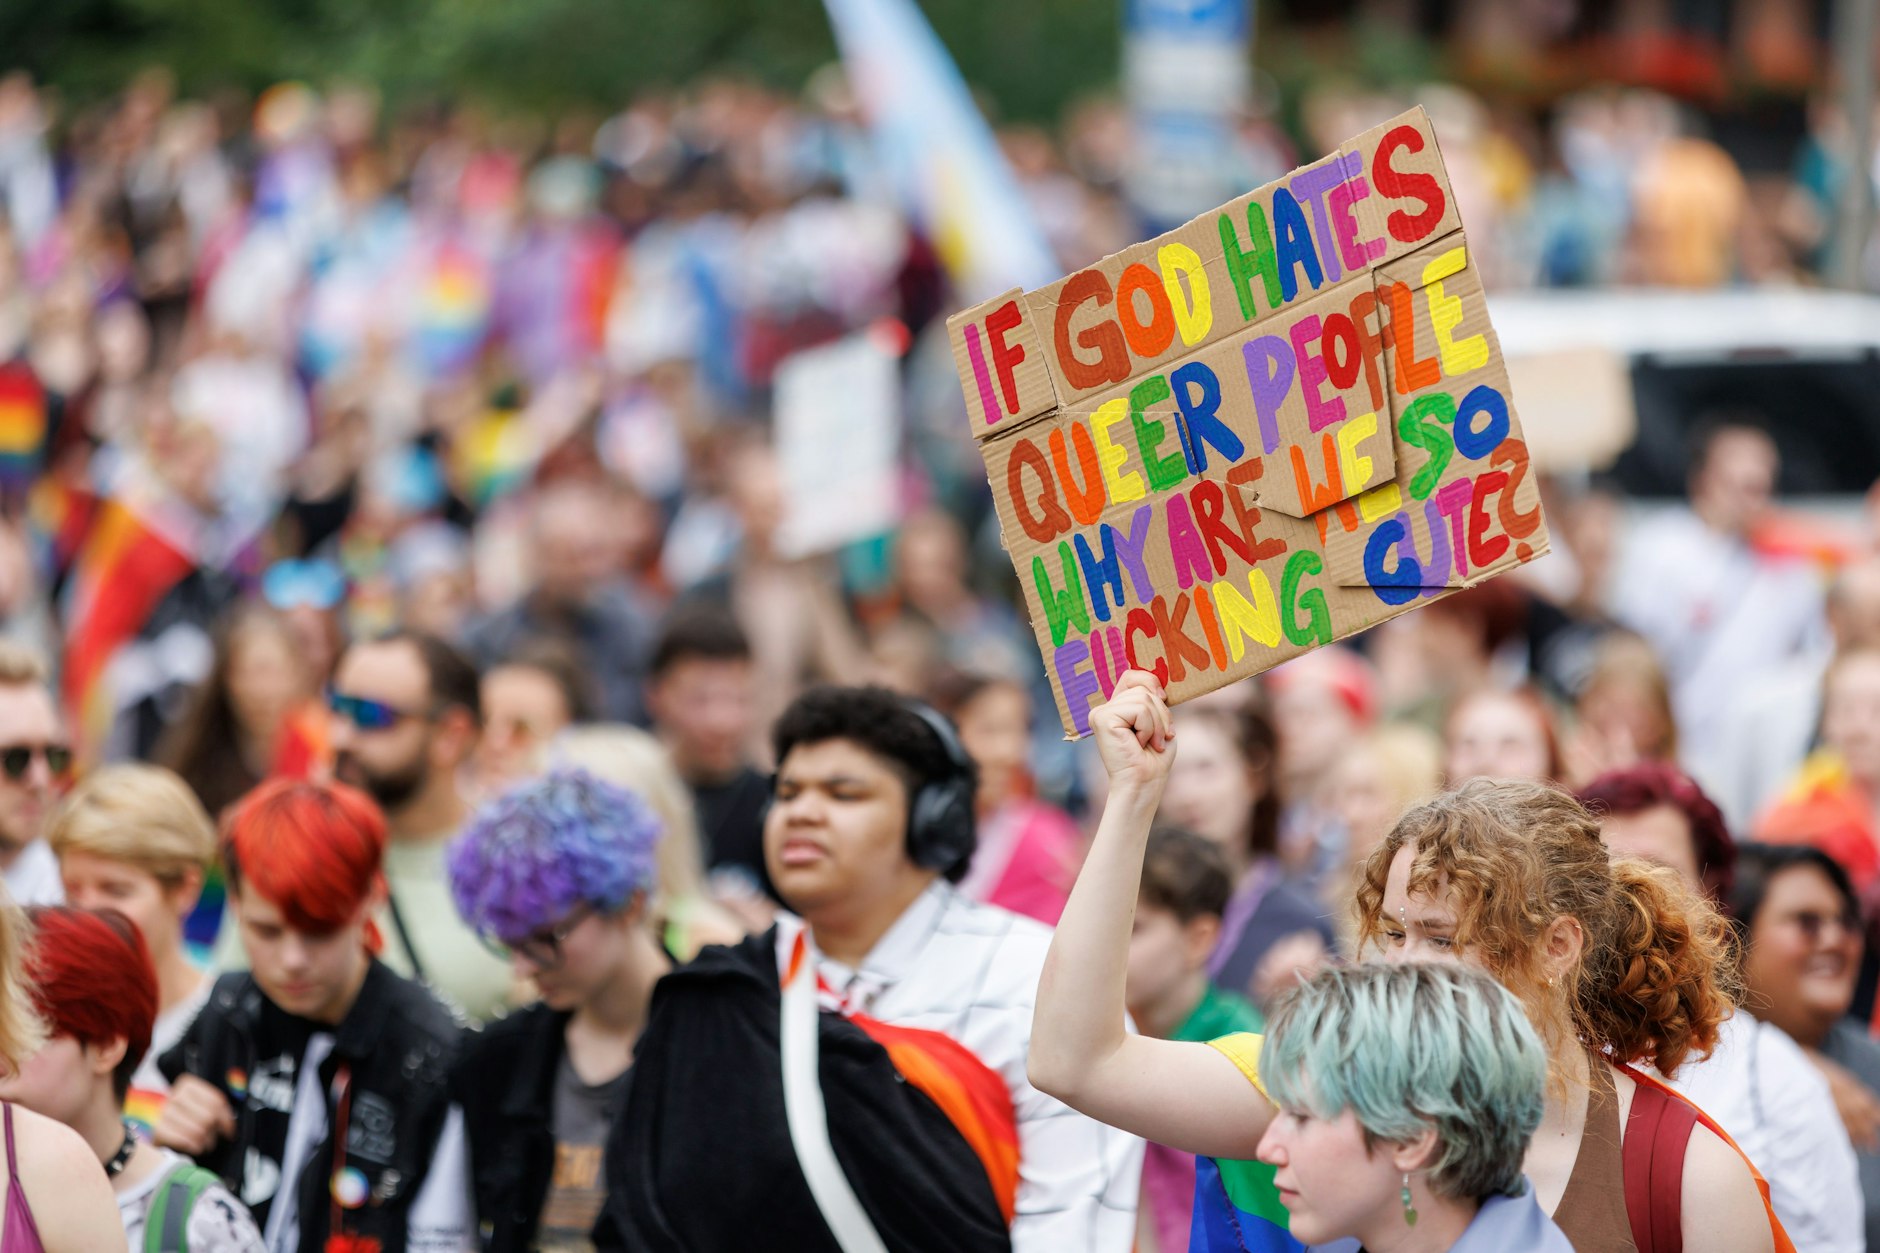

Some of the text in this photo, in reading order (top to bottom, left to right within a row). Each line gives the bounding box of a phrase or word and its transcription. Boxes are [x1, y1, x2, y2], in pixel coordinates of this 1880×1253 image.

[963, 125, 1446, 426] IF GOD HATES
[1007, 361, 1245, 544] QUEER
[1243, 247, 1489, 454] PEOPLE
[1032, 384, 1510, 648] WHY ARE WE SO
[1054, 438, 1541, 738] FUCKING CUTE?
